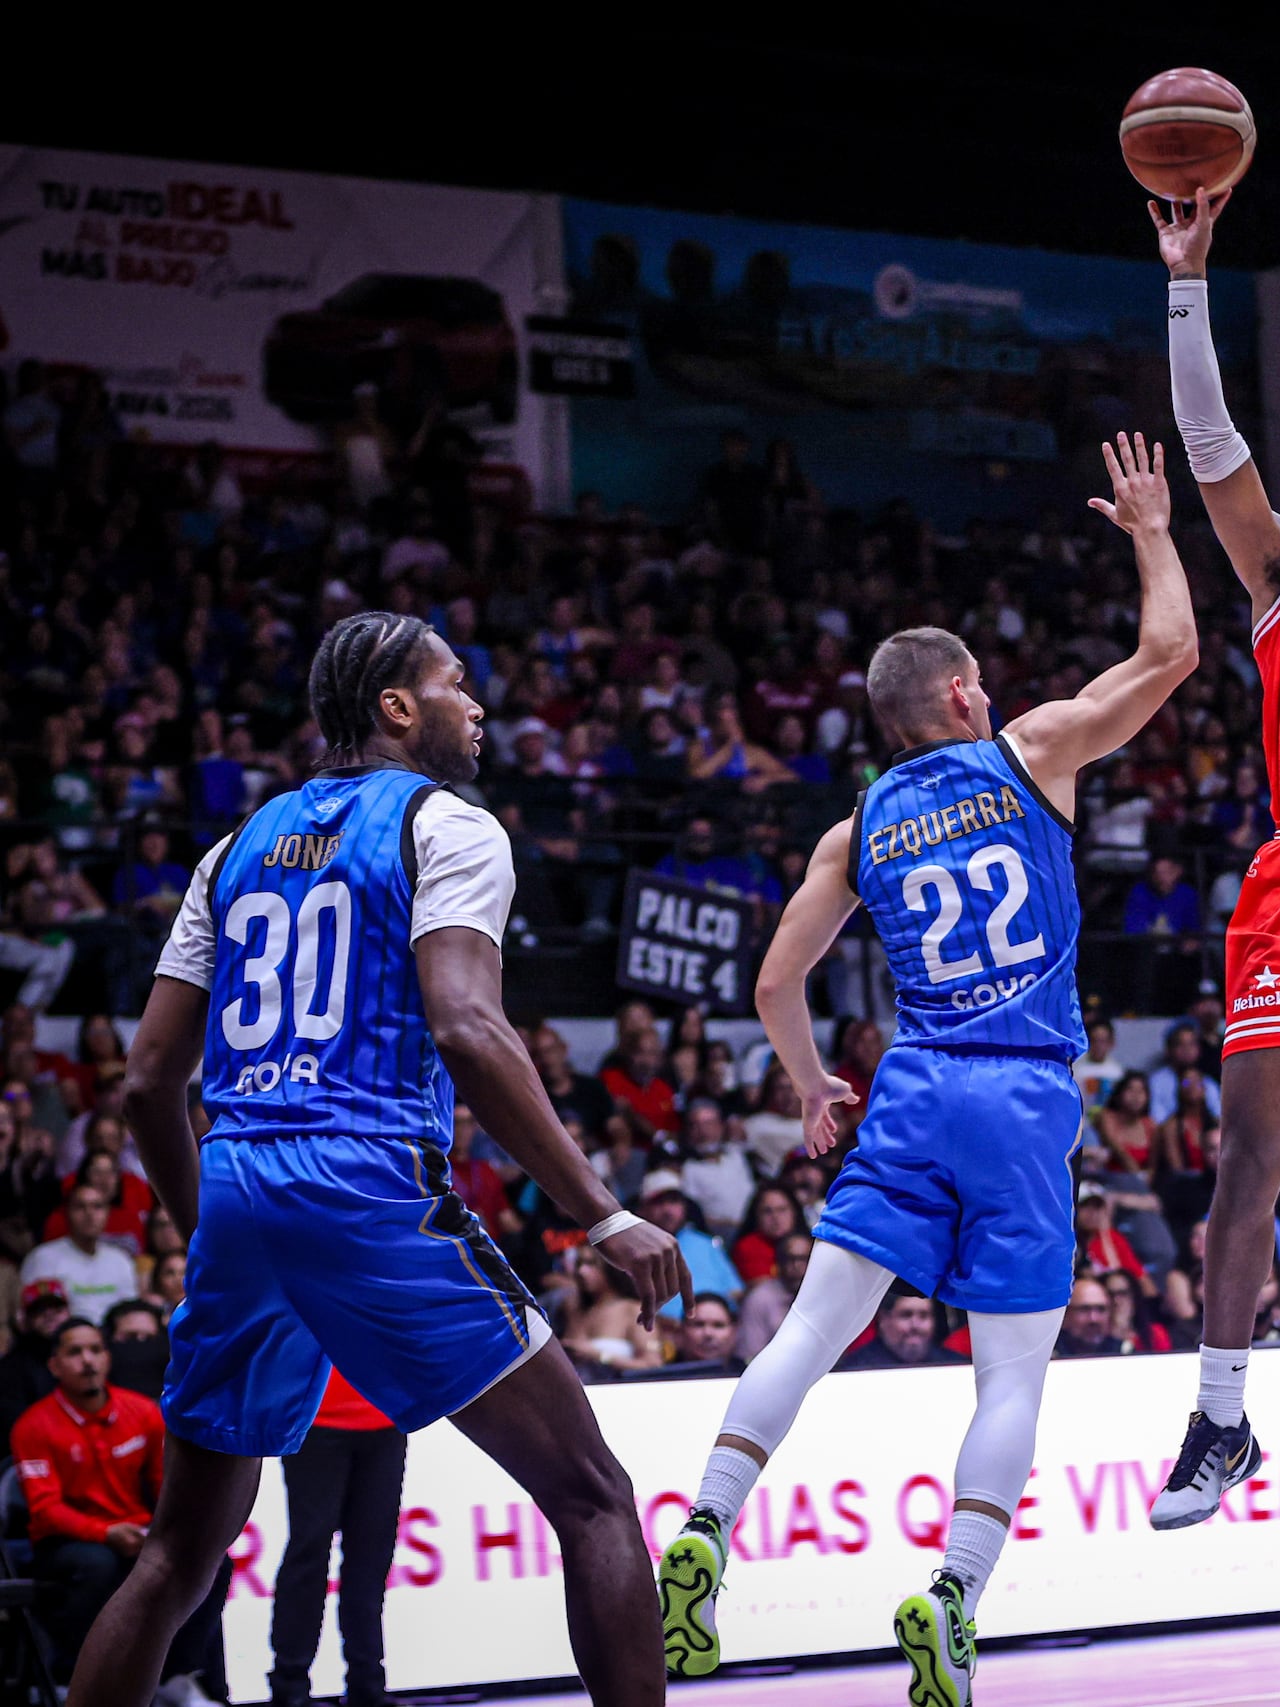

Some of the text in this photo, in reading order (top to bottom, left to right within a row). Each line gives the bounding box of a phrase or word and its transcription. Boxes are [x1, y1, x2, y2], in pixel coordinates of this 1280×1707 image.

[41, 180, 295, 231] TU AUTO IDEAL
[121, 220, 230, 257] PRECIO
[262, 828, 346, 871] JONE
[866, 785, 1026, 867] EZQUERRA
[636, 887, 741, 950] PALCO
[902, 843, 1047, 985] 22
[221, 880, 352, 1051] 30
[627, 937, 739, 1003] ESTE 4
[898, 1467, 1044, 1553] QE
